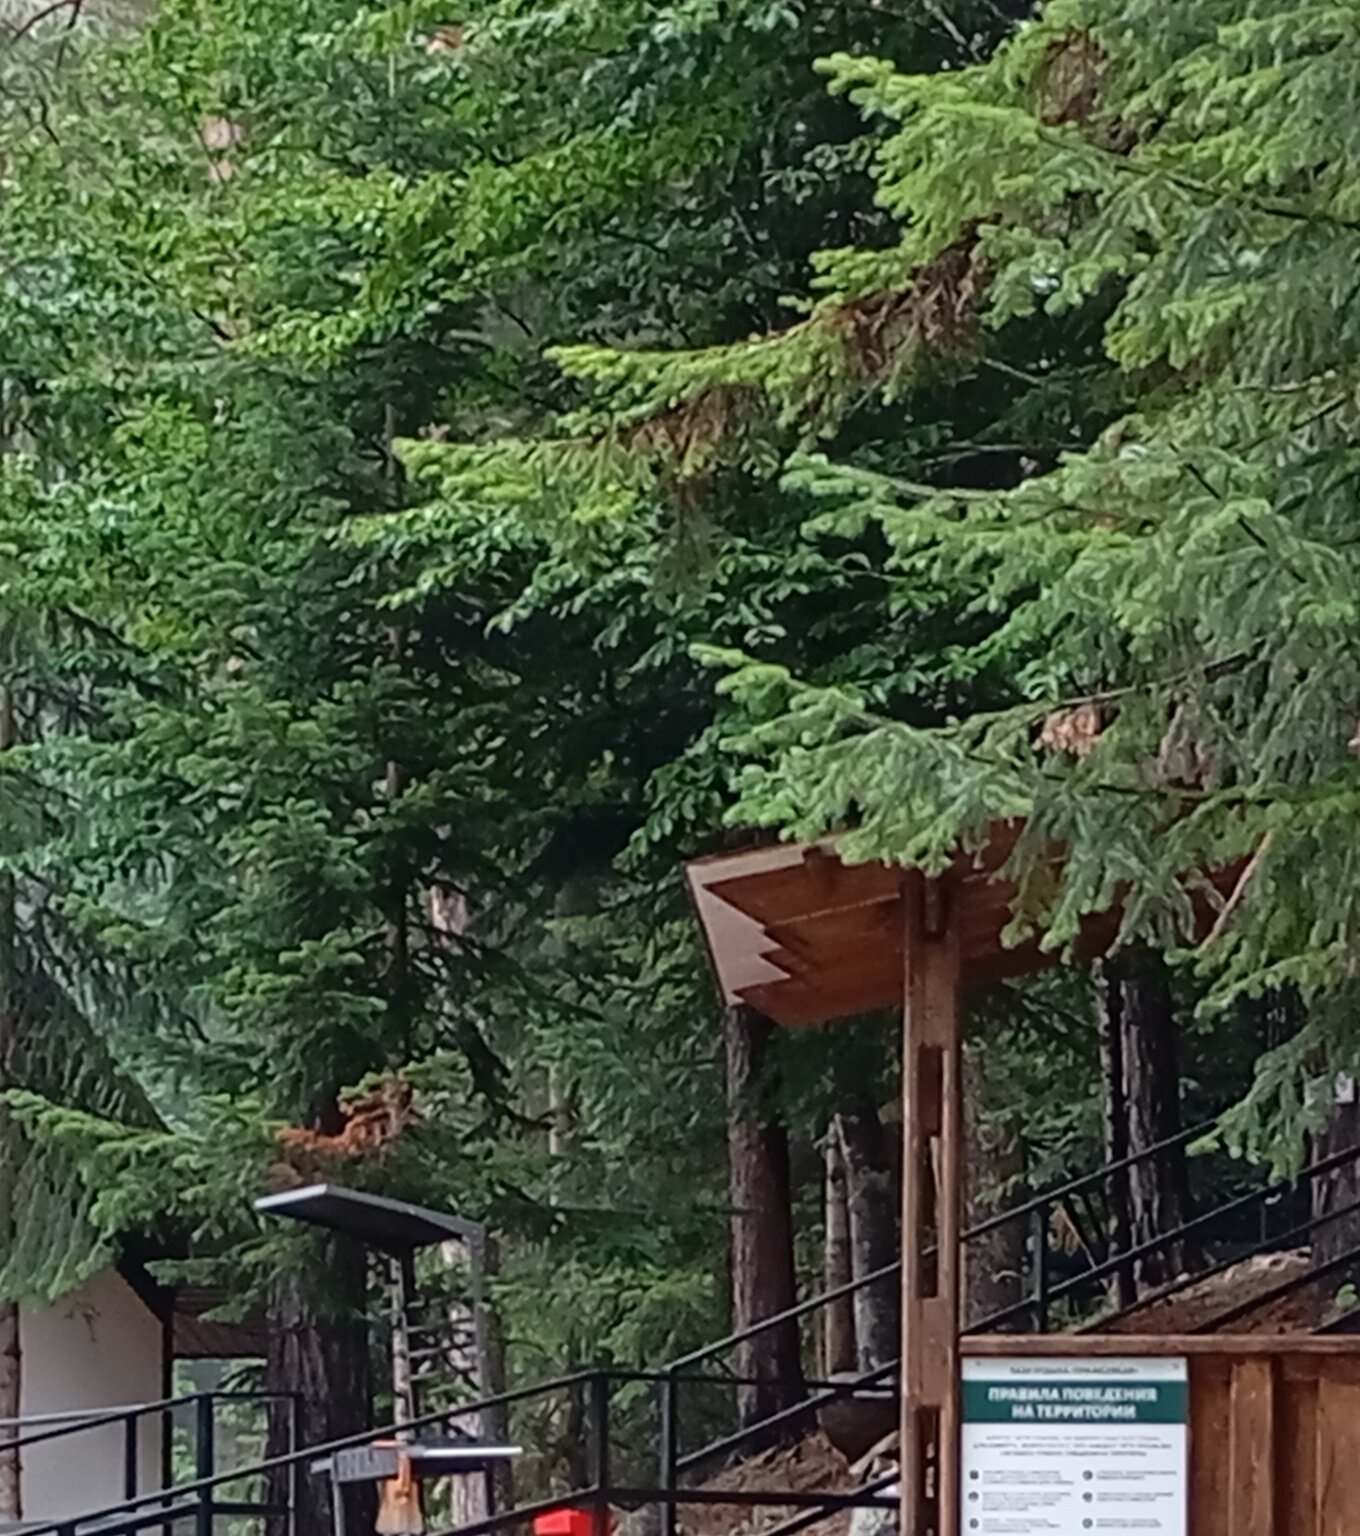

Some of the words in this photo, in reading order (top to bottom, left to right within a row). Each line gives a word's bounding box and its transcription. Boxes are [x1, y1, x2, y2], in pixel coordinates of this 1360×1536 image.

[988, 1386, 1060, 1402] ПРАВИЛА
[1061, 1386, 1158, 1402] ПОВЕДЕНИЯ
[1011, 1403, 1035, 1419] НА
[1036, 1403, 1137, 1419] ТЕРРИТОРИИ
